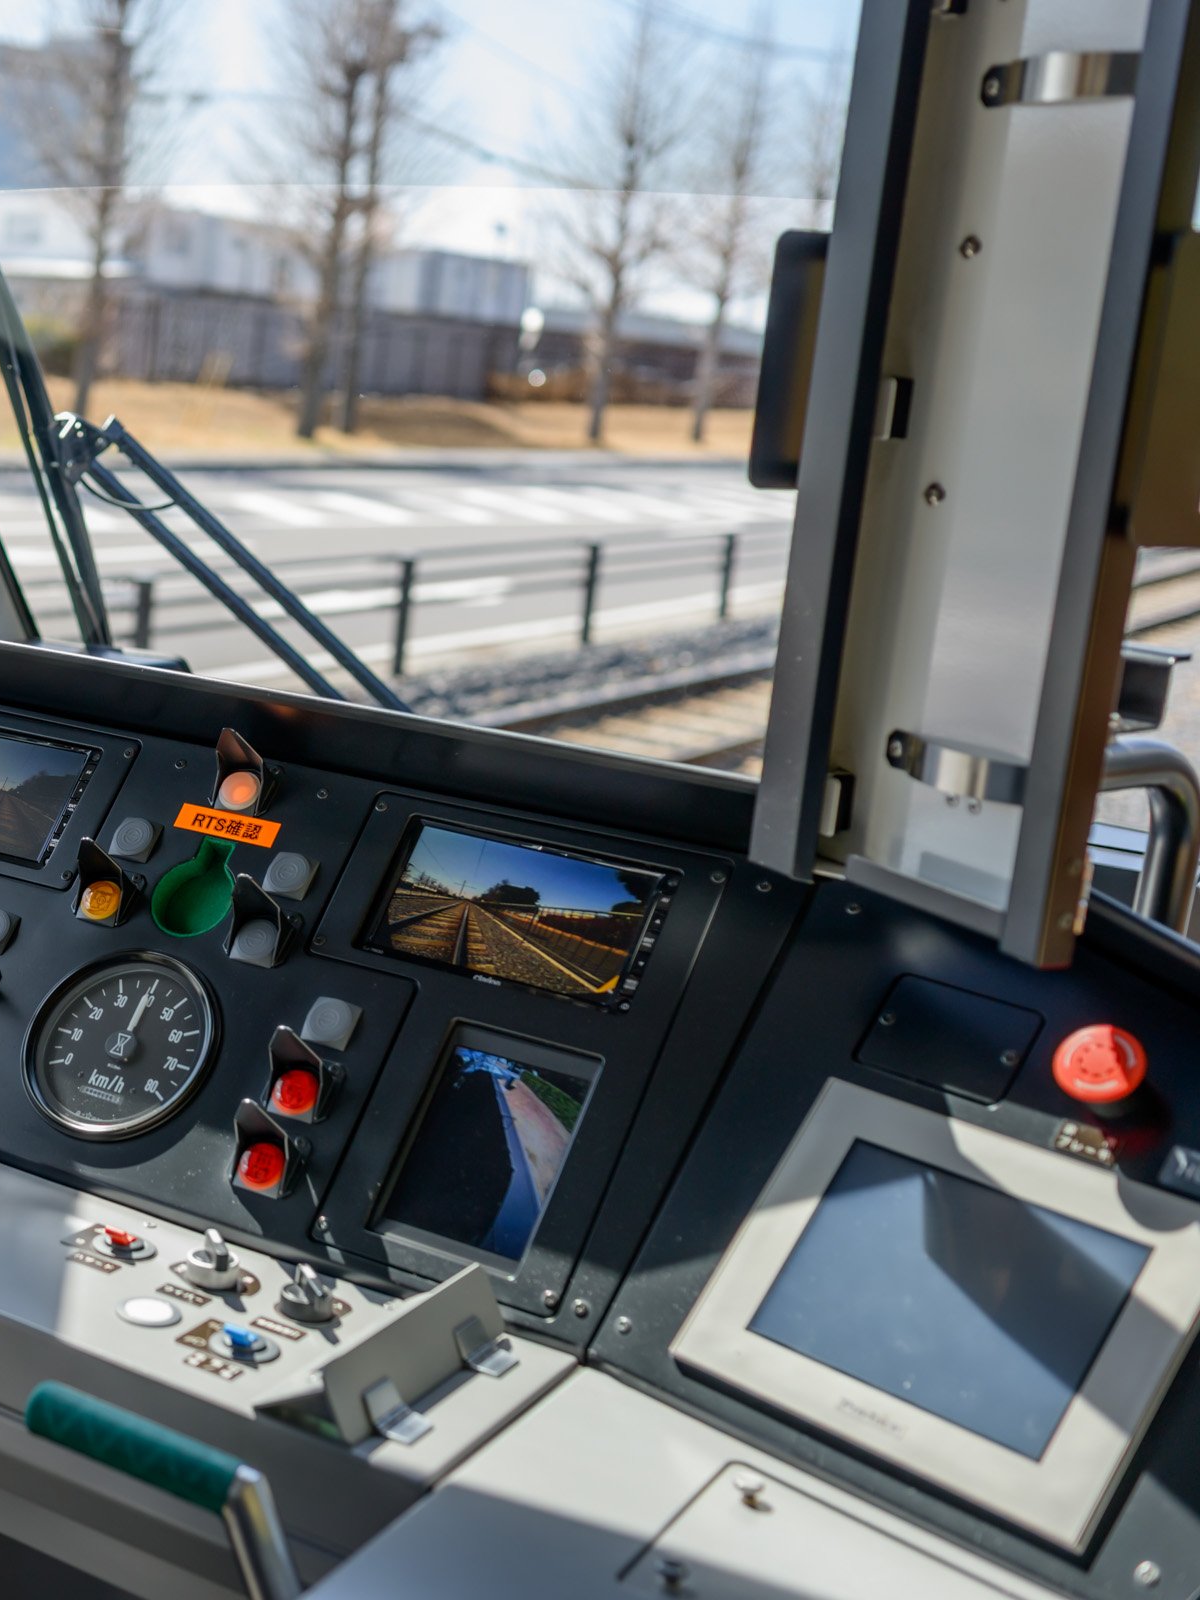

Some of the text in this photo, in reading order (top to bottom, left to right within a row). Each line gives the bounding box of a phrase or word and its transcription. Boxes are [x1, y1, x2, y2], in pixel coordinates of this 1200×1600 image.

[191, 813, 263, 840] RTS確認
[113, 994, 128, 1008] 30
[88, 1007, 104, 1020] 20
[160, 1007, 174, 1021] 50
[71, 1028, 83, 1042] 10
[168, 1029, 183, 1043] 60
[64, 1052, 74, 1065] 0
[163, 1056, 178, 1071] 70
[87, 1068, 125, 1094] km/h
[144, 1078, 159, 1093] 80
